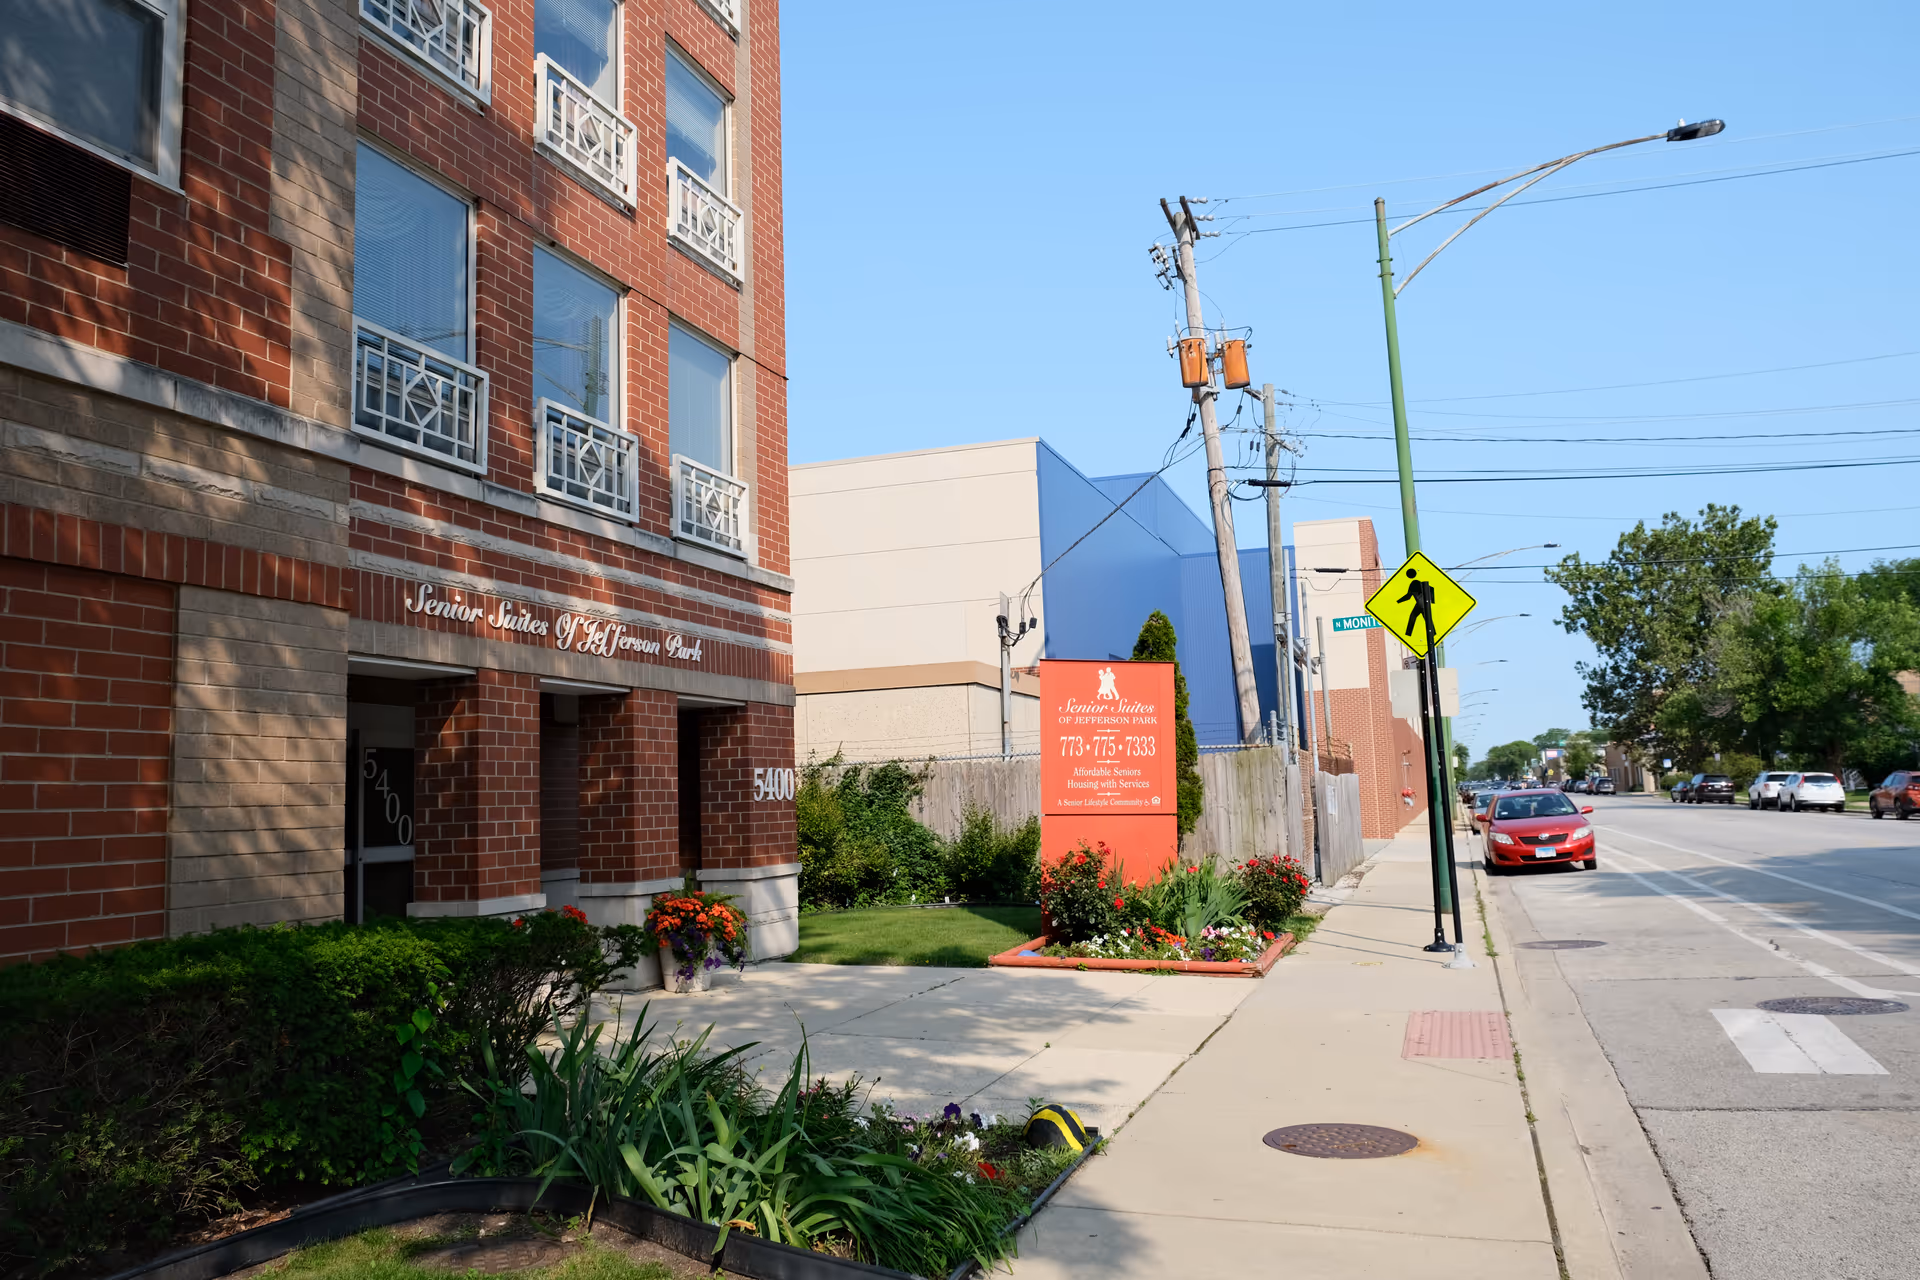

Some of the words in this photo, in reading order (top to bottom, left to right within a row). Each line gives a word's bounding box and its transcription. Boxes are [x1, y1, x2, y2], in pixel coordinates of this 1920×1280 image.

[406, 583, 483, 623] Senior
[488, 600, 549, 636] Suites
[555, 612, 581, 651] Of
[577, 619, 660, 658] Jefferson
[665, 633, 702, 663] Park
[1059, 698, 1108, 713] Senior
[1111, 698, 1155, 713] Suites
[1073, 767, 1111, 776] Affordable
[1113, 768, 1141, 776] Seniors
[753, 767, 795, 801] 5400
[1068, 780, 1098, 789] Housing
[1101, 780, 1116, 788] with
[1119, 780, 1149, 788] Services
[364, 749, 412, 845] 5400
